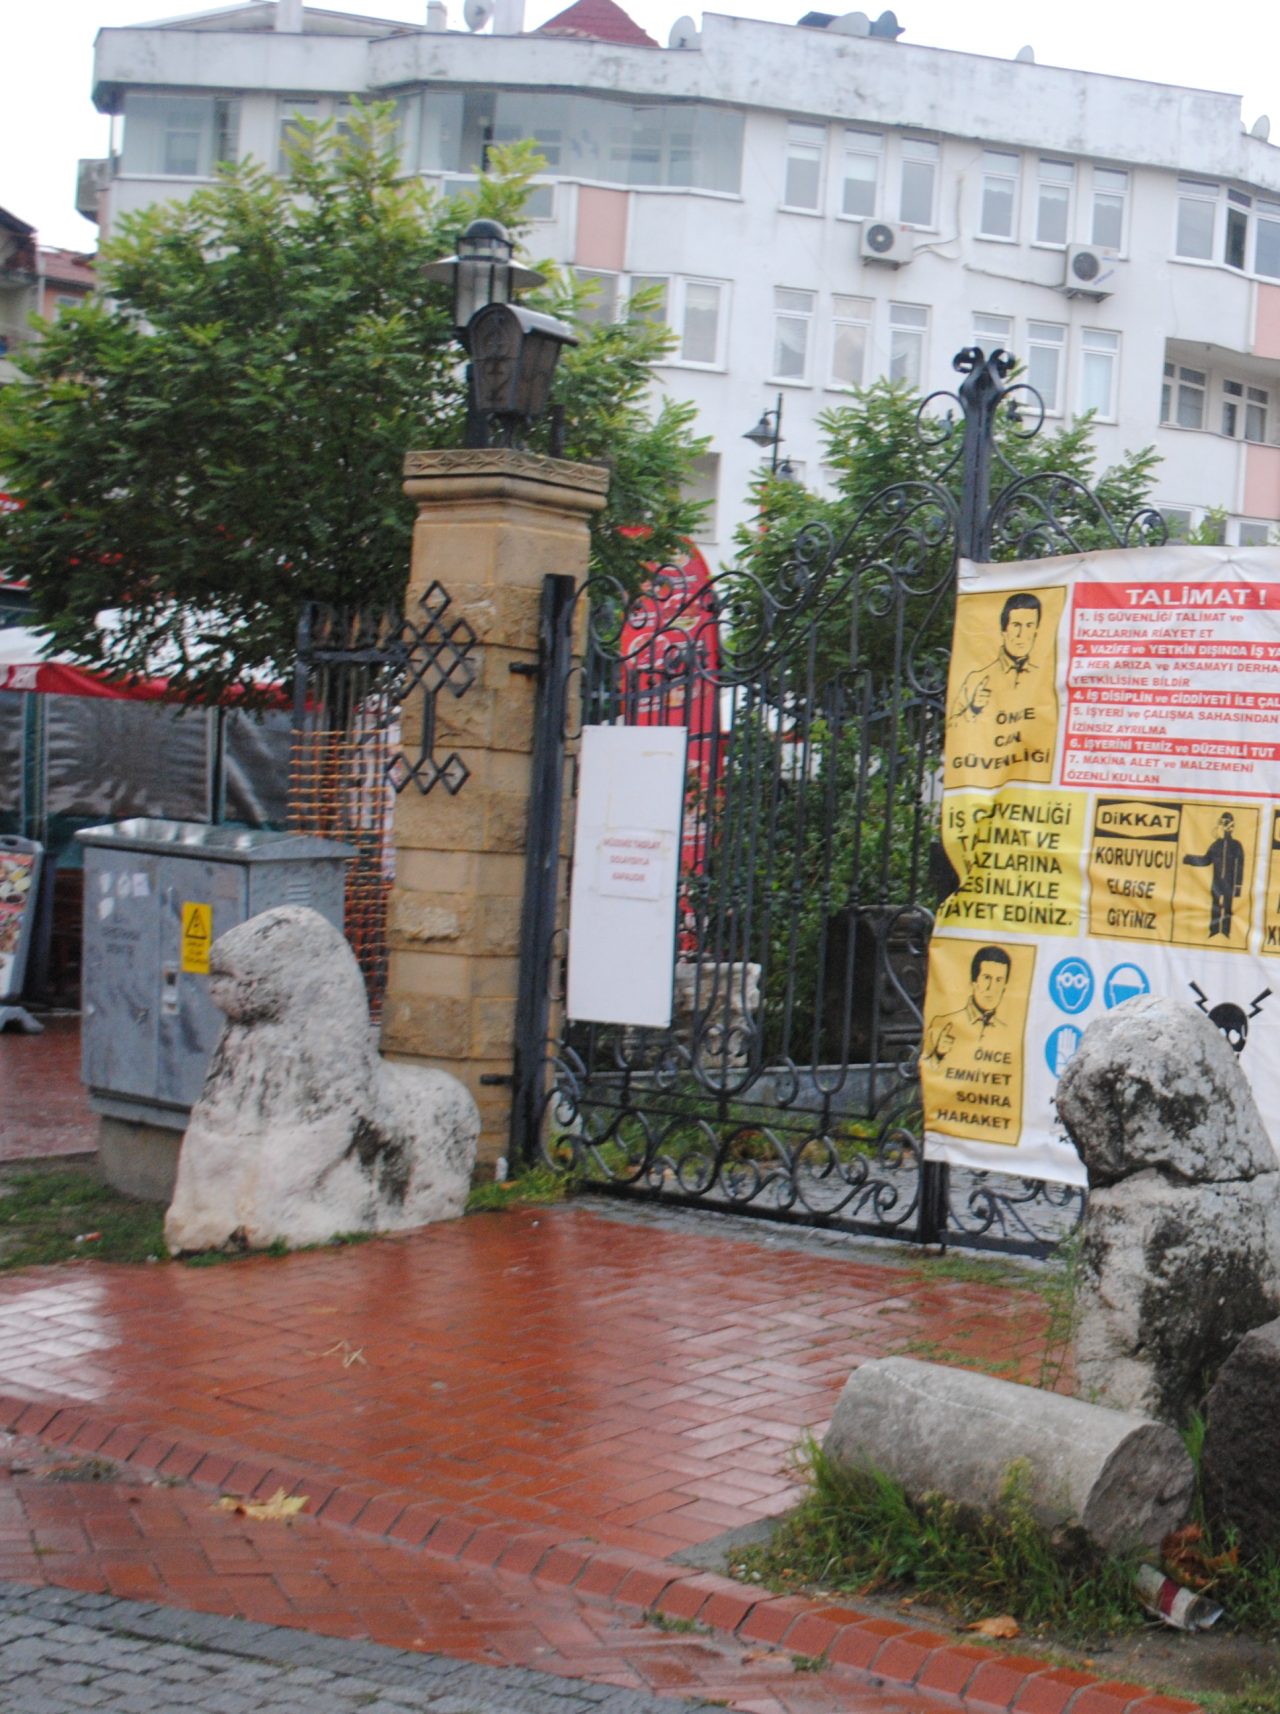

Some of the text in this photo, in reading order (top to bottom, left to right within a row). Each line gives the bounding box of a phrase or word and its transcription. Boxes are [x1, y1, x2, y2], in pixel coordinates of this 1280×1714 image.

[1126, 587, 1267, 606] TALİMAT !
[1175, 611, 1226, 622] TALİMAT
[1113, 661, 1151, 670] ARIZA
[1136, 740, 1172, 753] TEMİZ
[1192, 743, 1248, 757] DÜZENLİ
[1251, 747, 1275, 758] TUT
[1130, 758, 1160, 768] ALET
[949, 807, 966, 832] İŞ
[1037, 832, 1060, 849] VE
[1095, 846, 1174, 869] KORUYUCU
[954, 873, 1060, 899] ESİNLİKLE
[1003, 902, 1073, 926] EDİNİZ.
[974, 1049, 1012, 1064] ÖNCE
[945, 1067, 1012, 1086] EMNİYET
[956, 1090, 1012, 1108] SONRA
[937, 1108, 1011, 1129] HARAKET
